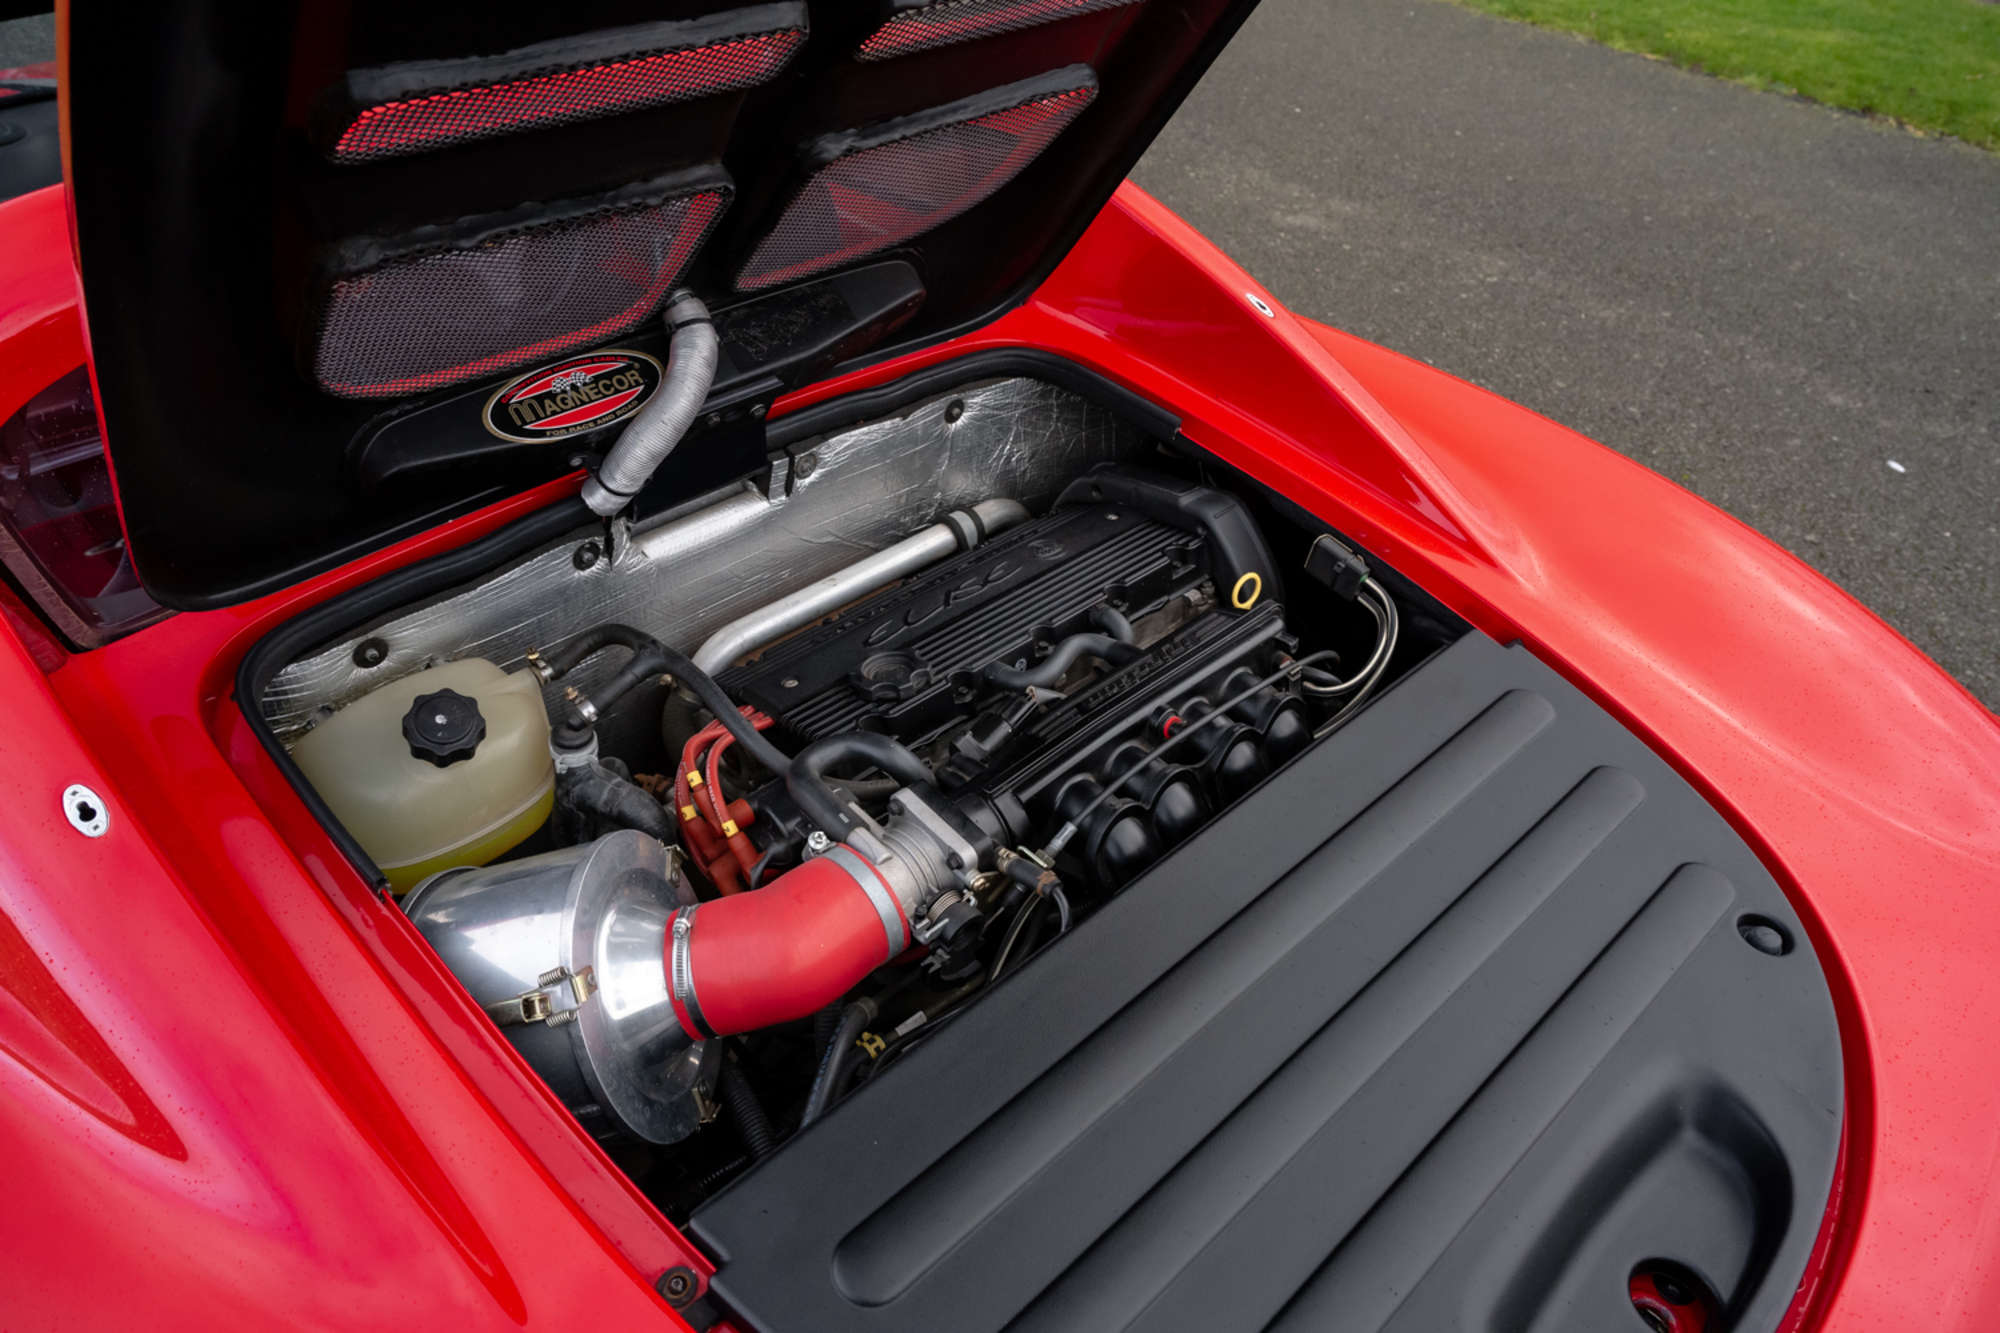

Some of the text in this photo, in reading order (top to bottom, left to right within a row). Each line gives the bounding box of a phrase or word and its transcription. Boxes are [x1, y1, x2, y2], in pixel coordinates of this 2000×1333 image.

[508, 370, 644, 426] MAGNECOR
[546, 400, 639, 436] FOR RACE AND ROAD
